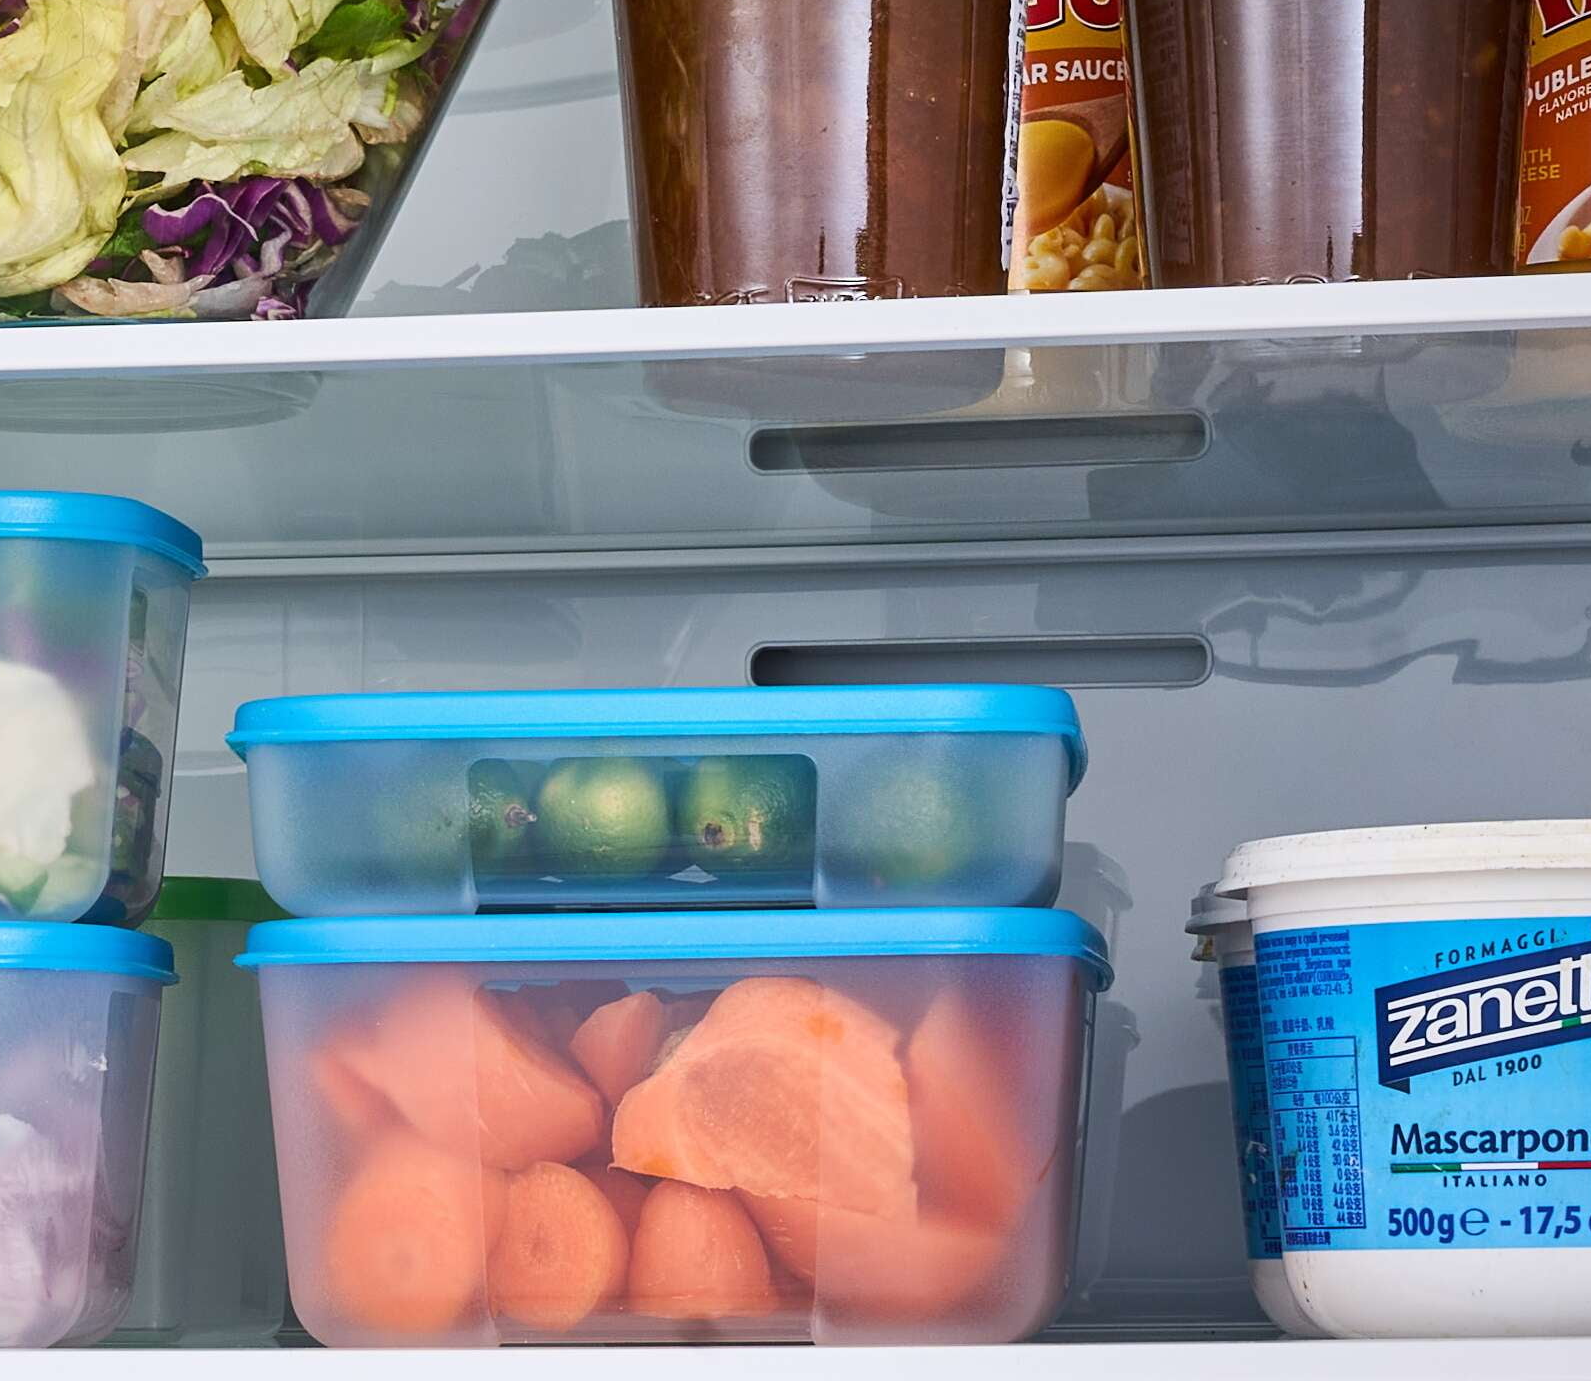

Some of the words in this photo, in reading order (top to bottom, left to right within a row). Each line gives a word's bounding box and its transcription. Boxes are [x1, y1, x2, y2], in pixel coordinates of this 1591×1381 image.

[1522, 148, 1552, 164] ITH
[1434, 928, 1556, 970] FORMAGGI
[1452, 1062, 1487, 1088] DAL
[1495, 1054, 1543, 1080] 1900
[1442, 1173, 1547, 1188] ITALIANO
[1519, 1206, 1582, 1242] 17,5
